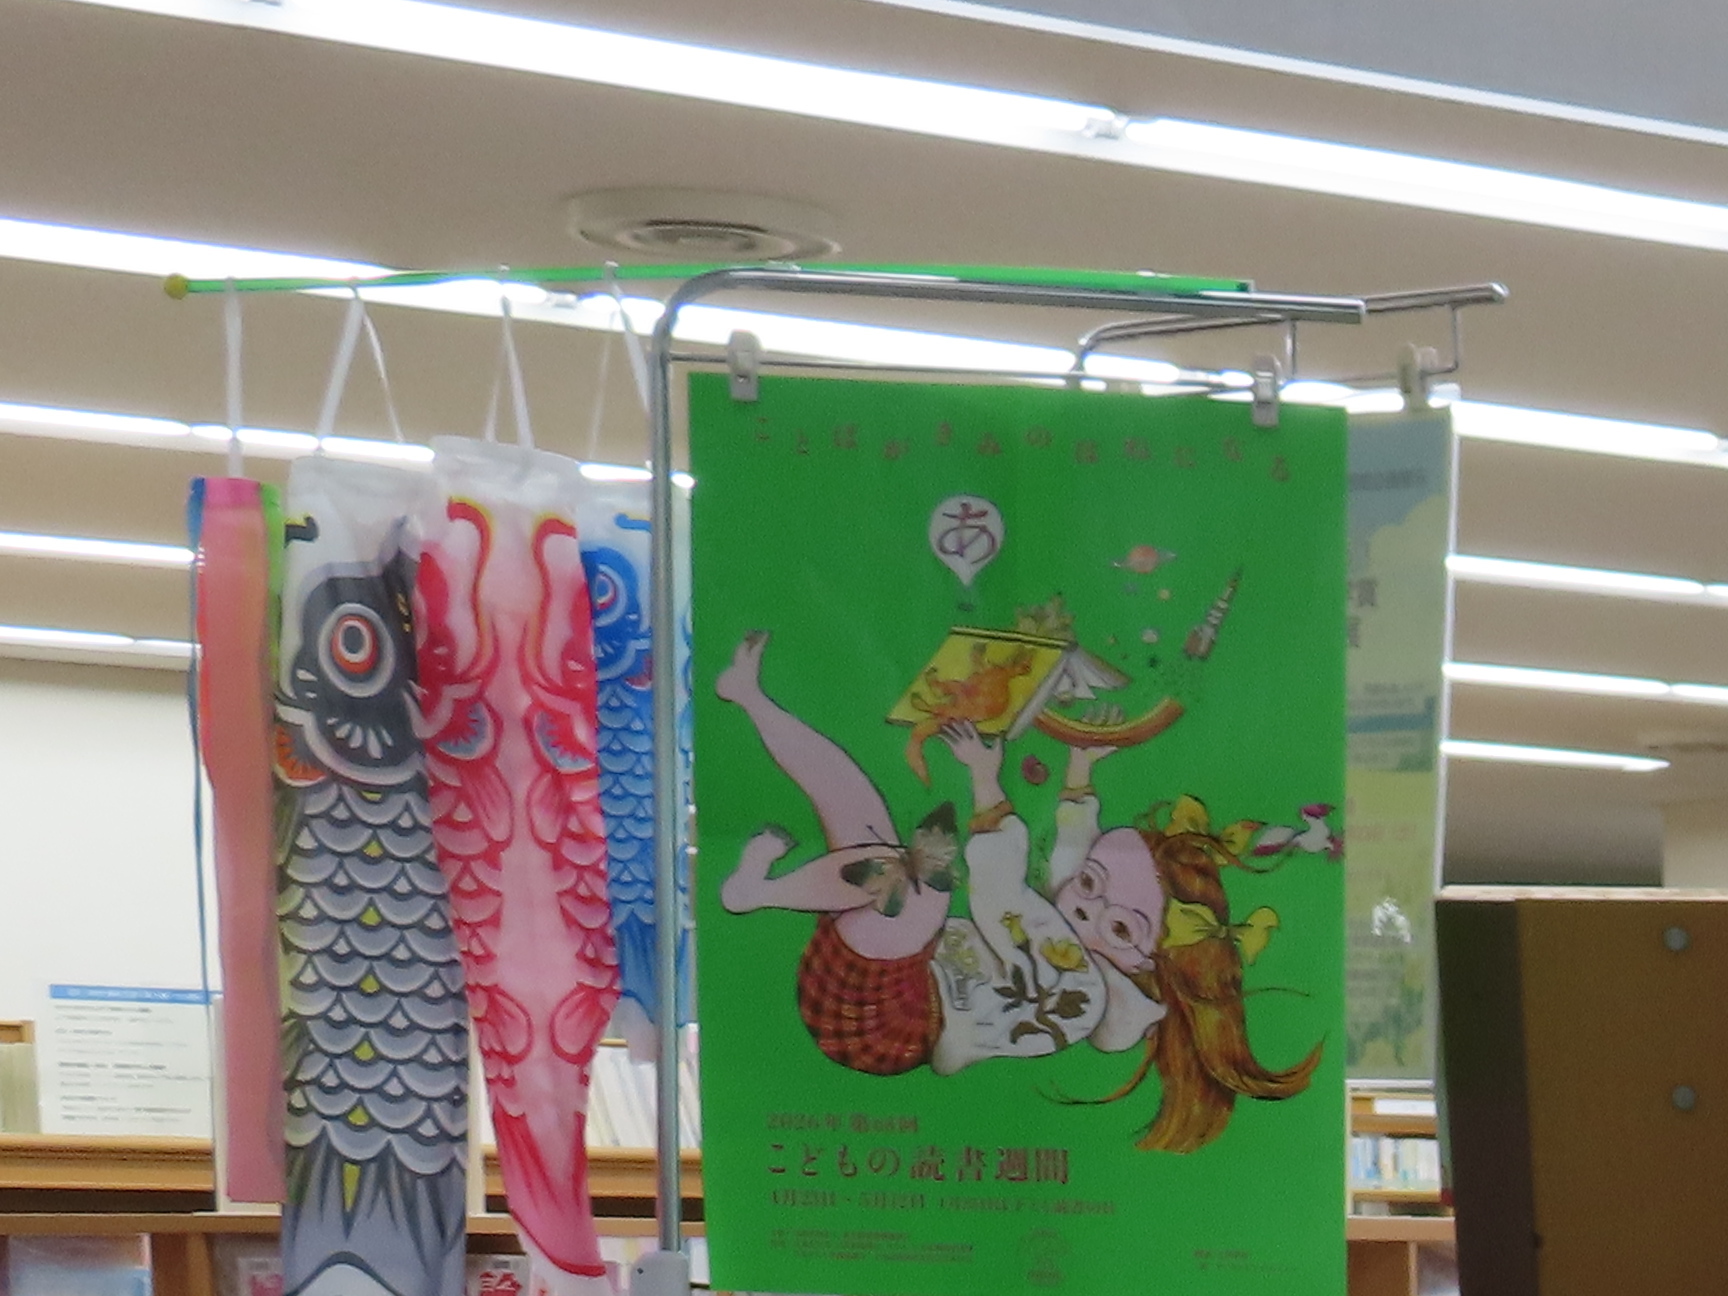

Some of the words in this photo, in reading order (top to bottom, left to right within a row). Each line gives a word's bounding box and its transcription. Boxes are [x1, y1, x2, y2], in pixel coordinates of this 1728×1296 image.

[937, 501, 998, 559] あ
[767, 1143, 1069, 1184] こどもの読書週間
